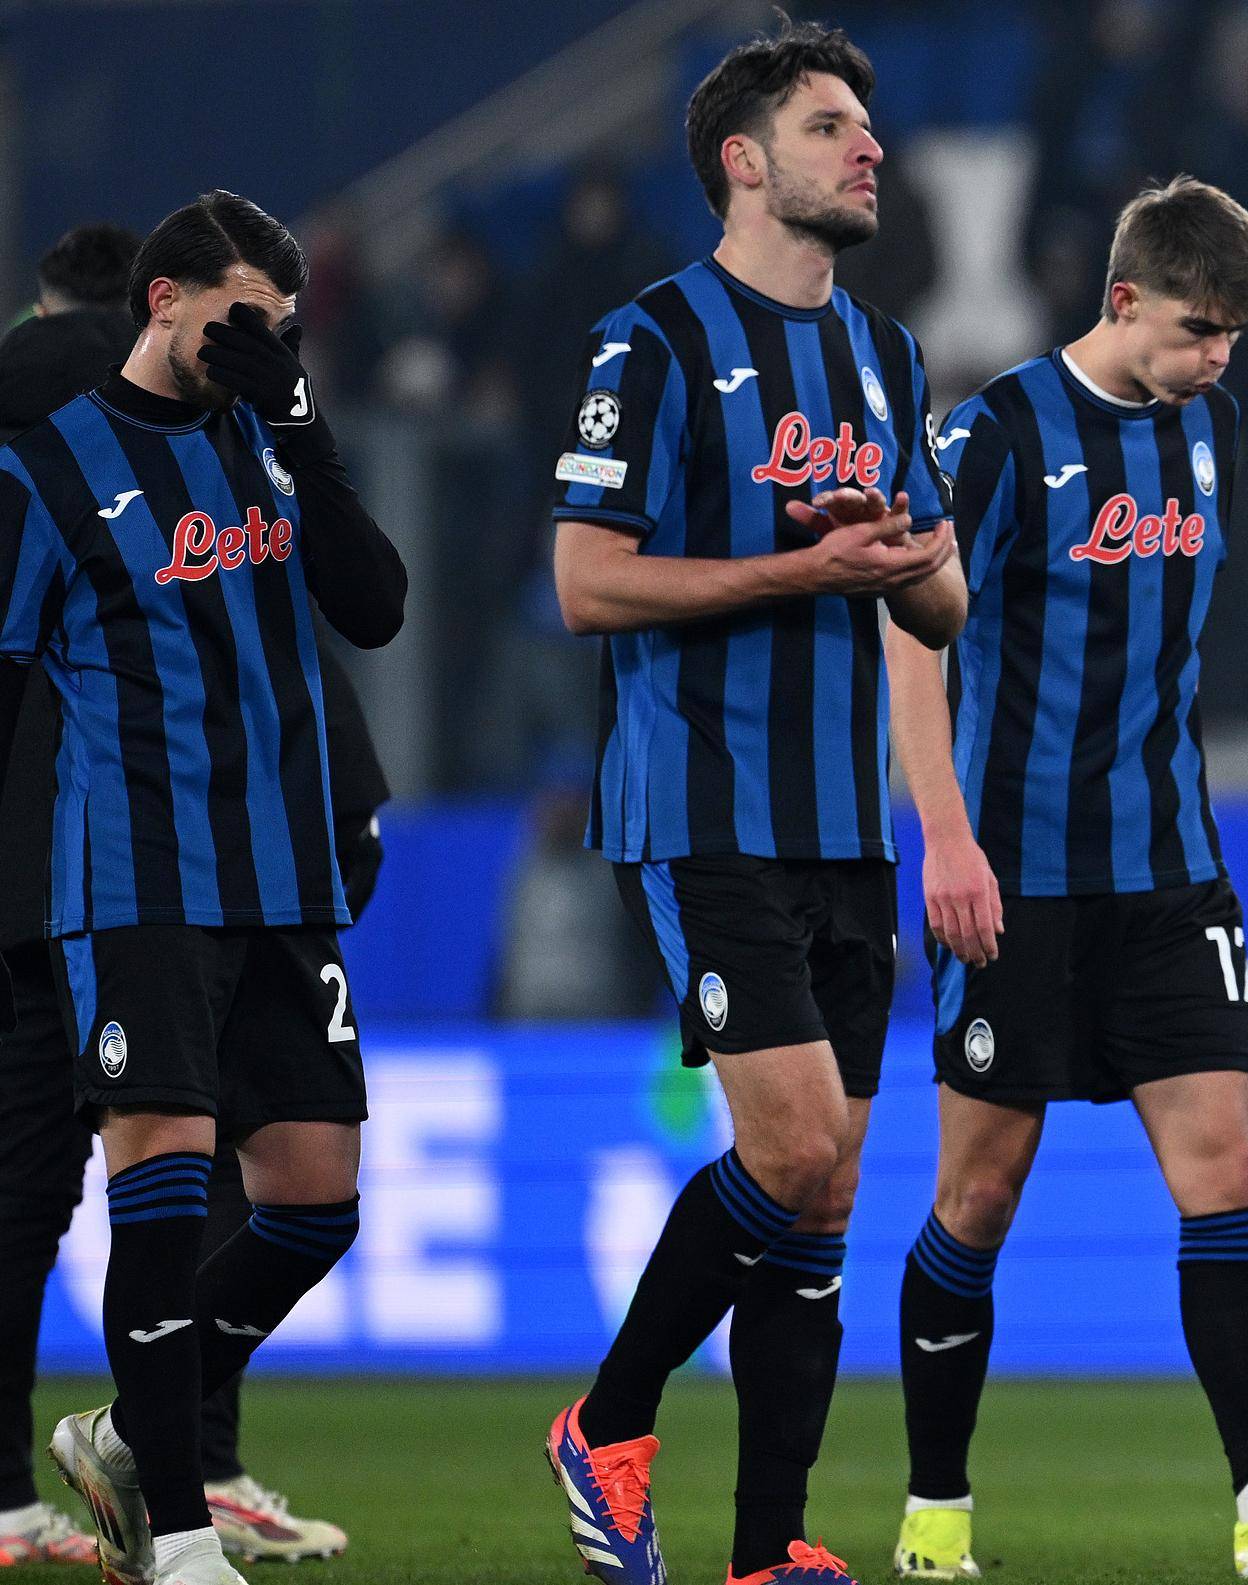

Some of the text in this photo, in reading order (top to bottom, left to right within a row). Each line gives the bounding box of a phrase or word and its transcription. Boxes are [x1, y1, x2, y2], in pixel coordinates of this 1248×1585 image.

[751, 411, 884, 487] Lete
[154, 506, 293, 585] Lete
[1069, 493, 1206, 565] Lete
